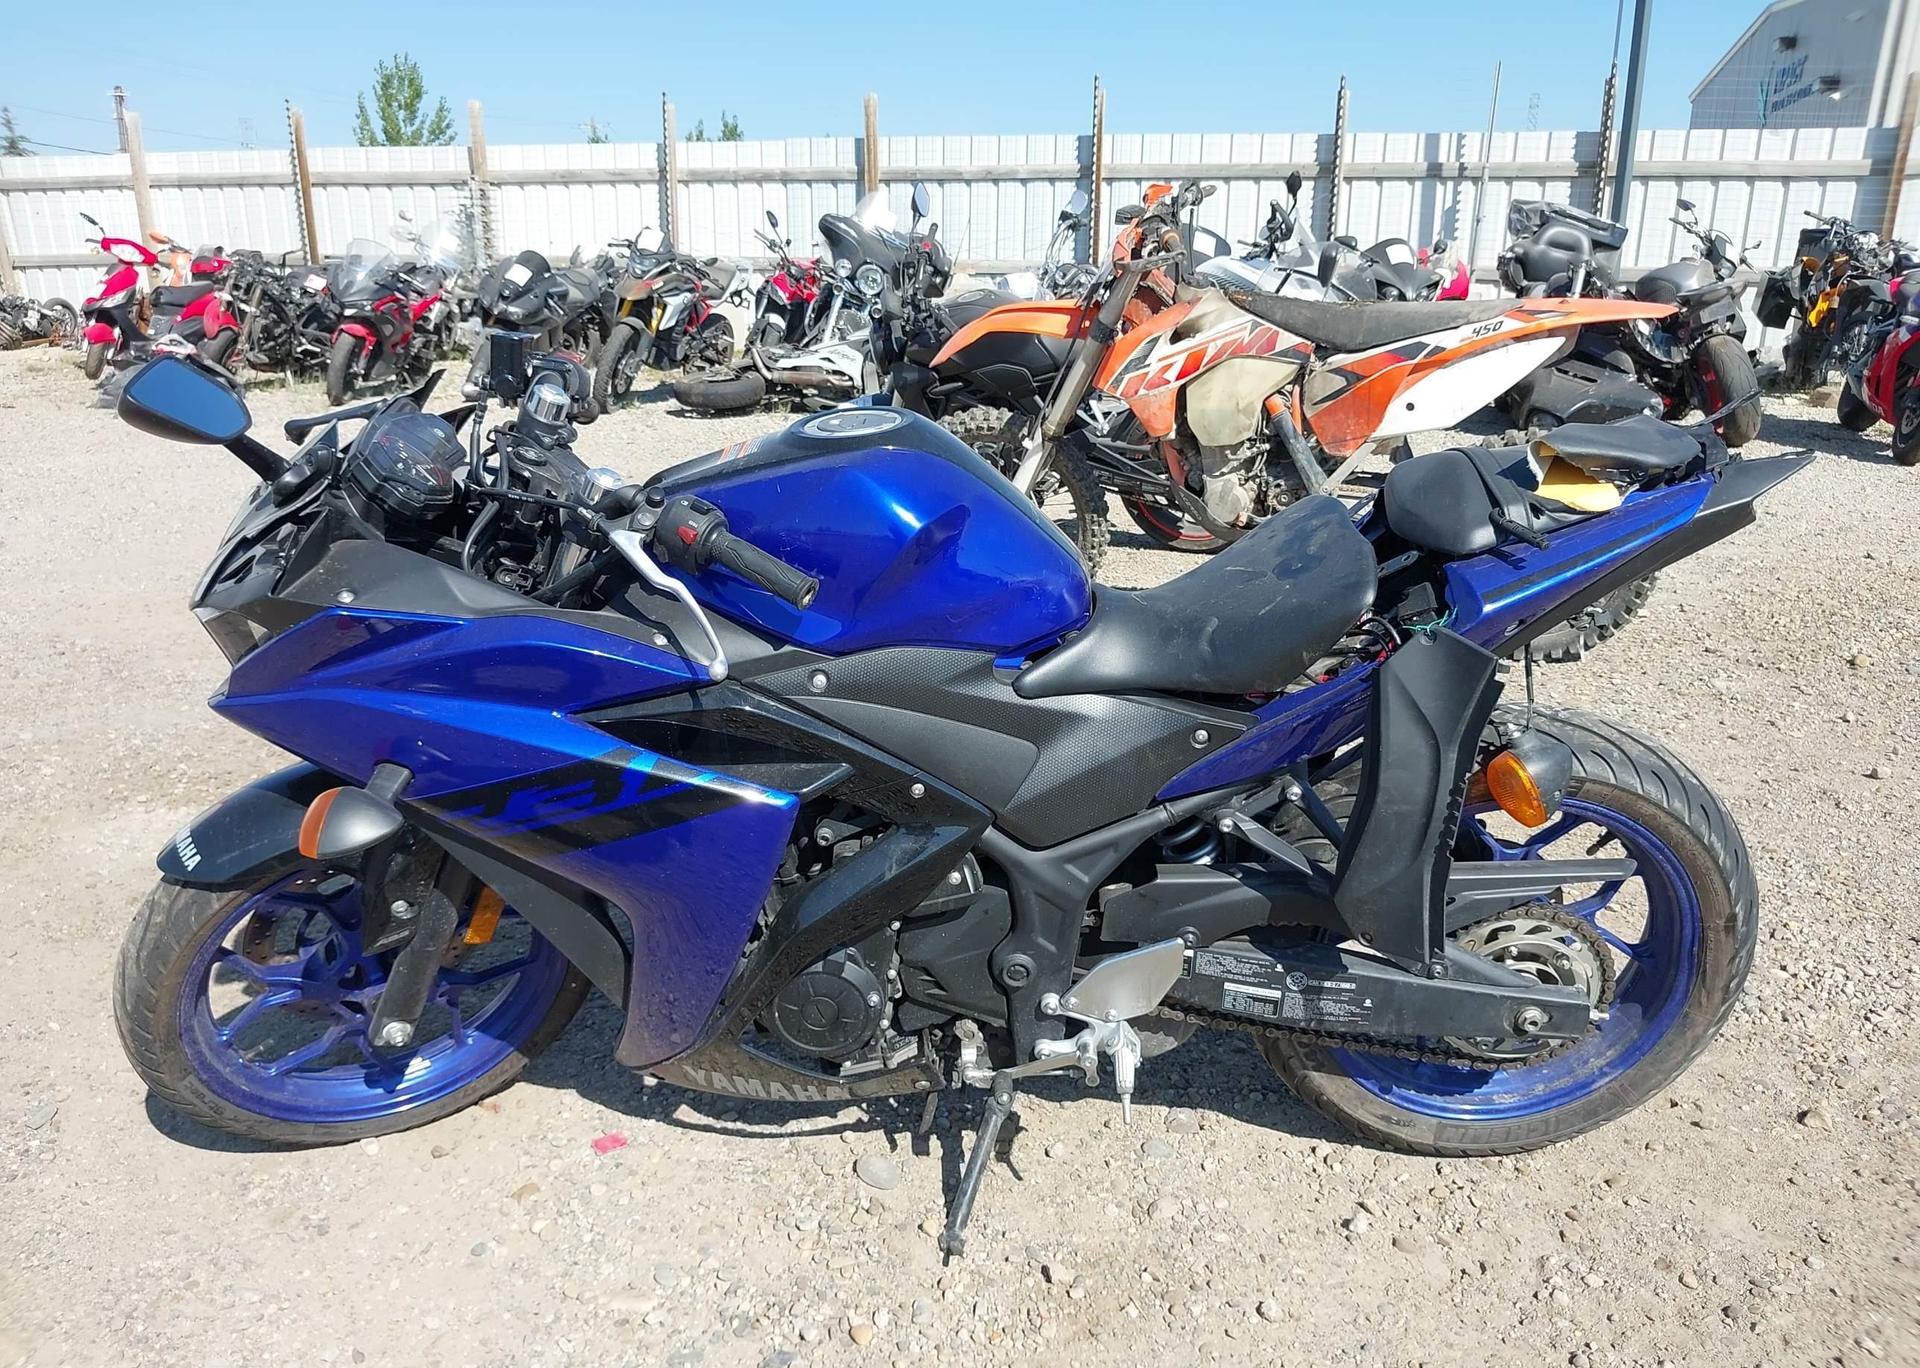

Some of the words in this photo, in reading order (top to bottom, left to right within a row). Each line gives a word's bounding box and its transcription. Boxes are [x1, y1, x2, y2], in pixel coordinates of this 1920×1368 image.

[1471, 320, 1505, 338] 450
[1117, 324, 1281, 399] KTM
[681, 1055, 852, 1101] YAMAHA
